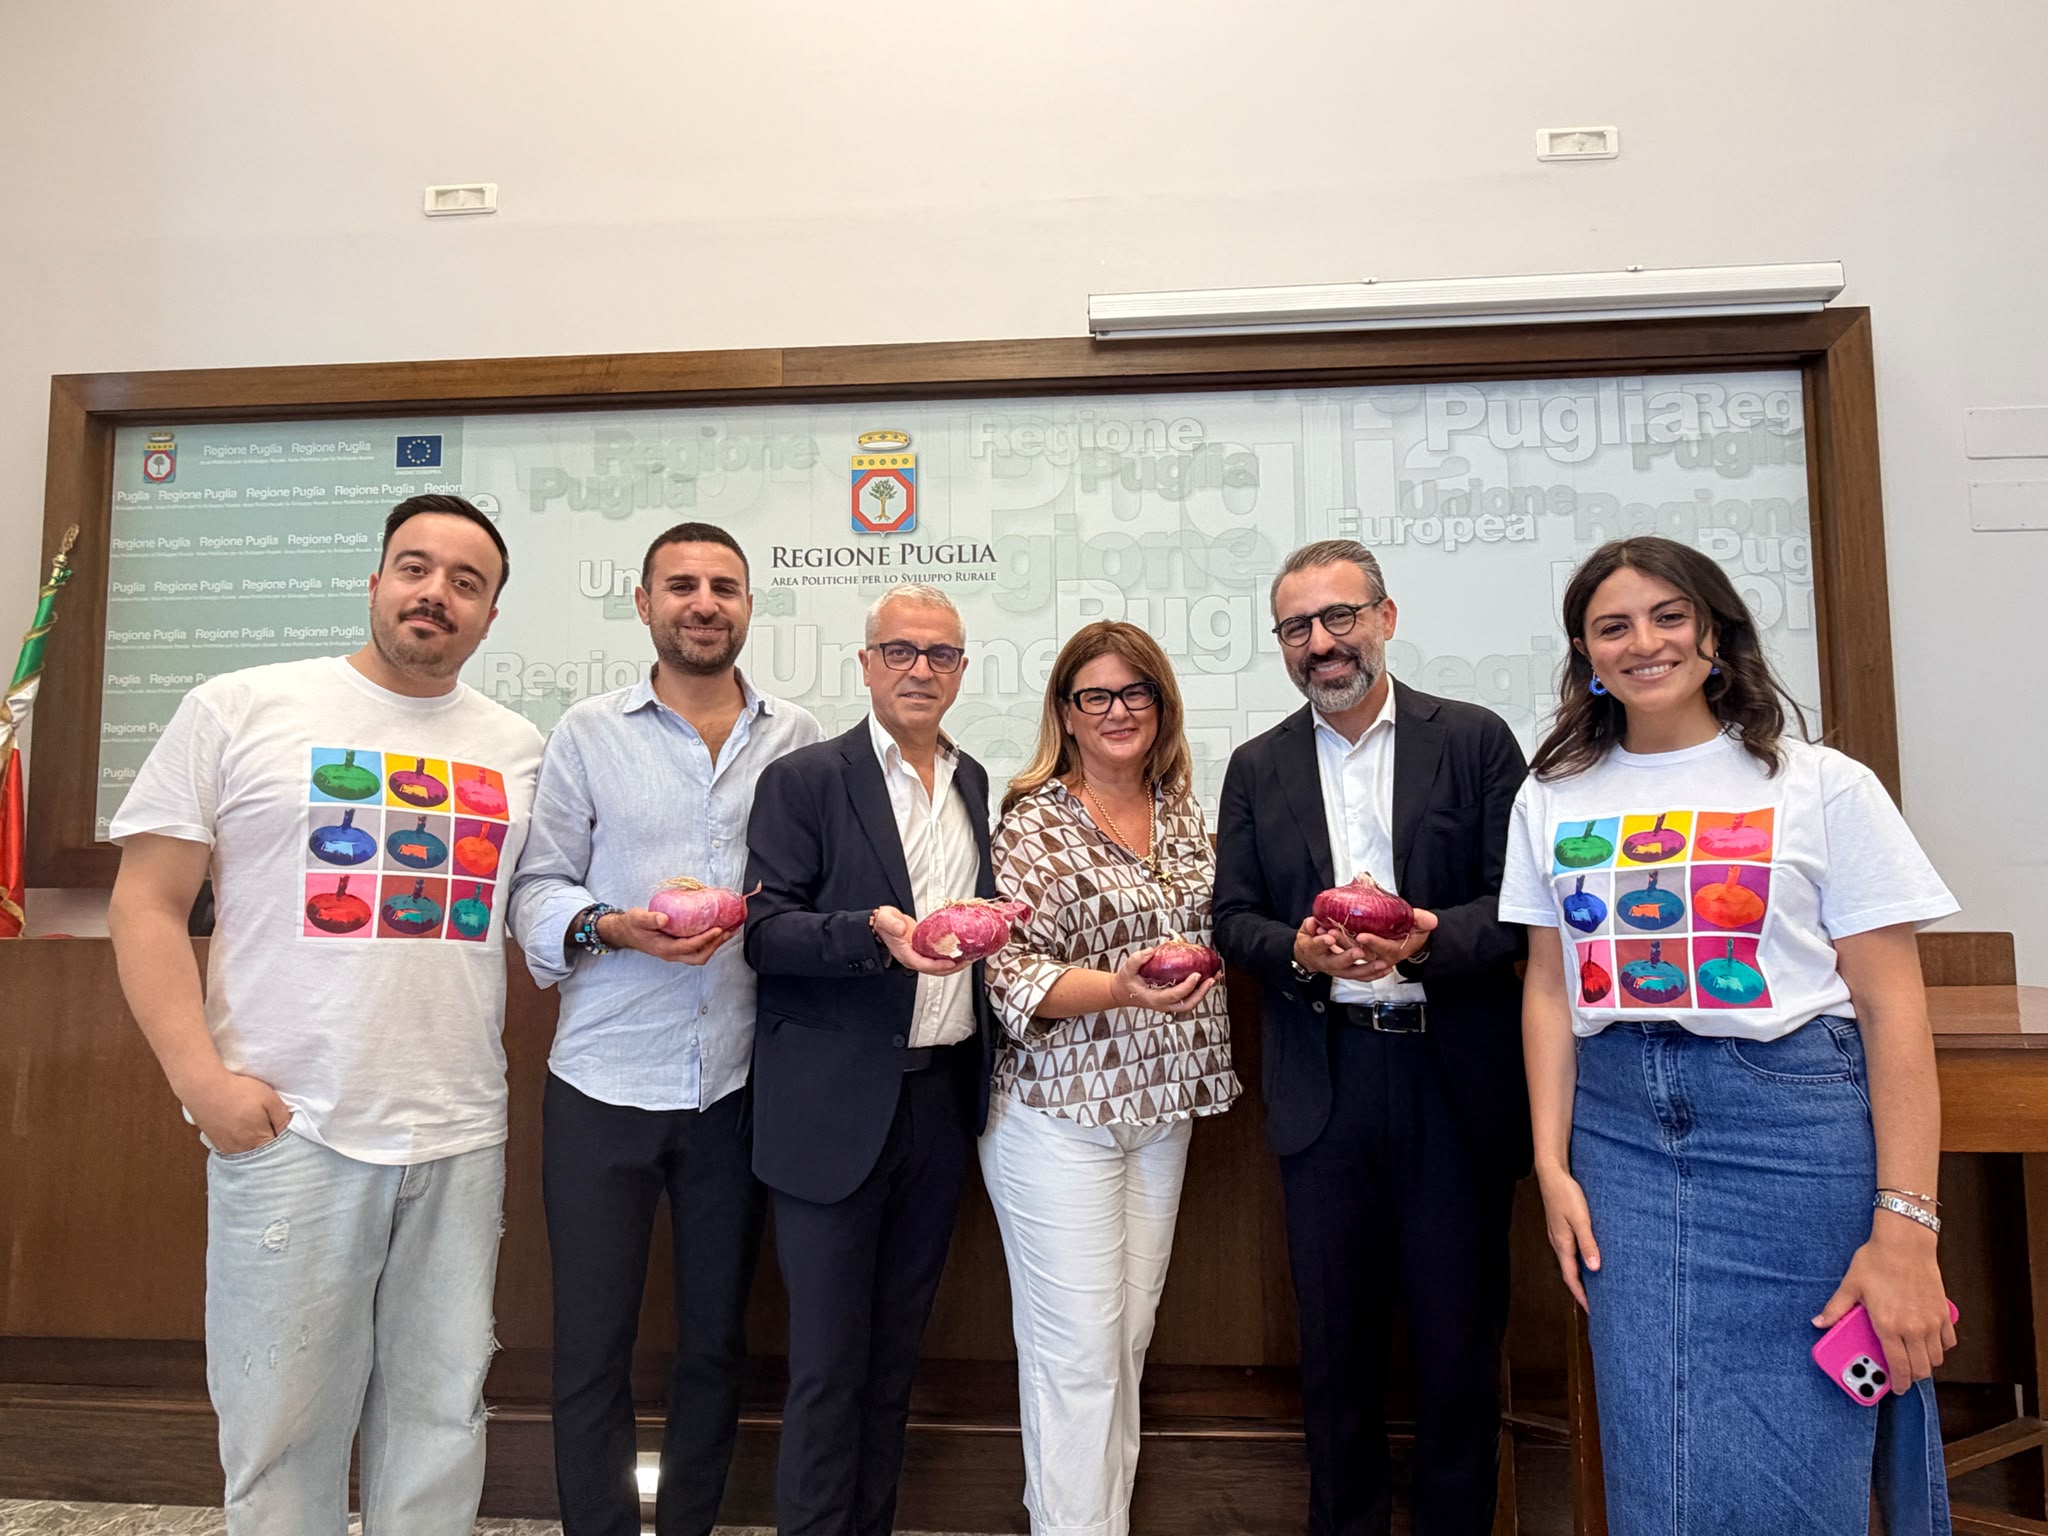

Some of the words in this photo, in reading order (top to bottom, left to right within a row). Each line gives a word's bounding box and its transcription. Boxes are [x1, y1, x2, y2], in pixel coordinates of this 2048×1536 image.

[968, 409, 1205, 467] Regione
[1425, 378, 1702, 463] Puglia
[203, 444, 248, 457] Regione
[249, 443, 283, 456] Puglia
[291, 442, 336, 455] Regione
[337, 440, 372, 454] Puglia
[594, 424, 817, 481] Regione
[1080, 443, 1261, 502] Puglia
[117, 490, 151, 503] Puglia
[158, 489, 202, 502] Regione
[204, 487, 238, 500] Puglia
[246, 486, 291, 500] Regione
[292, 485, 326, 498] Puglia
[334, 484, 380, 497] Regione
[381, 483, 416, 496] Puglia
[529, 462, 698, 520] Puglia
[1399, 476, 1577, 519] Unione
[112, 538, 156, 550] Regione
[157, 536, 191, 549] Puglia
[200, 535, 244, 549] Regione
[245, 534, 279, 548] Puglia
[287, 533, 332, 546] Regione
[334, 532, 369, 545] Puglia
[1327, 507, 1537, 552] Europea
[771, 546, 891, 569] REGIONE
[900, 542, 998, 565] PUGLIA
[112, 582, 146, 594] Puglia
[154, 580, 198, 593] Regione
[200, 579, 234, 592] Puglia
[242, 578, 287, 591] Regione
[288, 577, 323, 590] Puglia
[331, 577, 370, 589] Region
[771, 577, 799, 586] AREA
[955, 571, 997, 582] RURALE
[108, 630, 152, 642] Regione
[153, 628, 187, 641] Puglia
[195, 627, 240, 641] Regione
[241, 626, 276, 639] Puglia
[283, 625, 329, 638] Regione
[331, 625, 366, 638] Puglia
[1056, 574, 1281, 675] Pugl
[483, 650, 652, 704] Regio
[752, 624, 1058, 698] Unne
[107, 673, 142, 686] Puglia
[149, 672, 194, 685] Regione
[103, 721, 147, 735] Regione
[103, 767, 137, 779] Puglia
